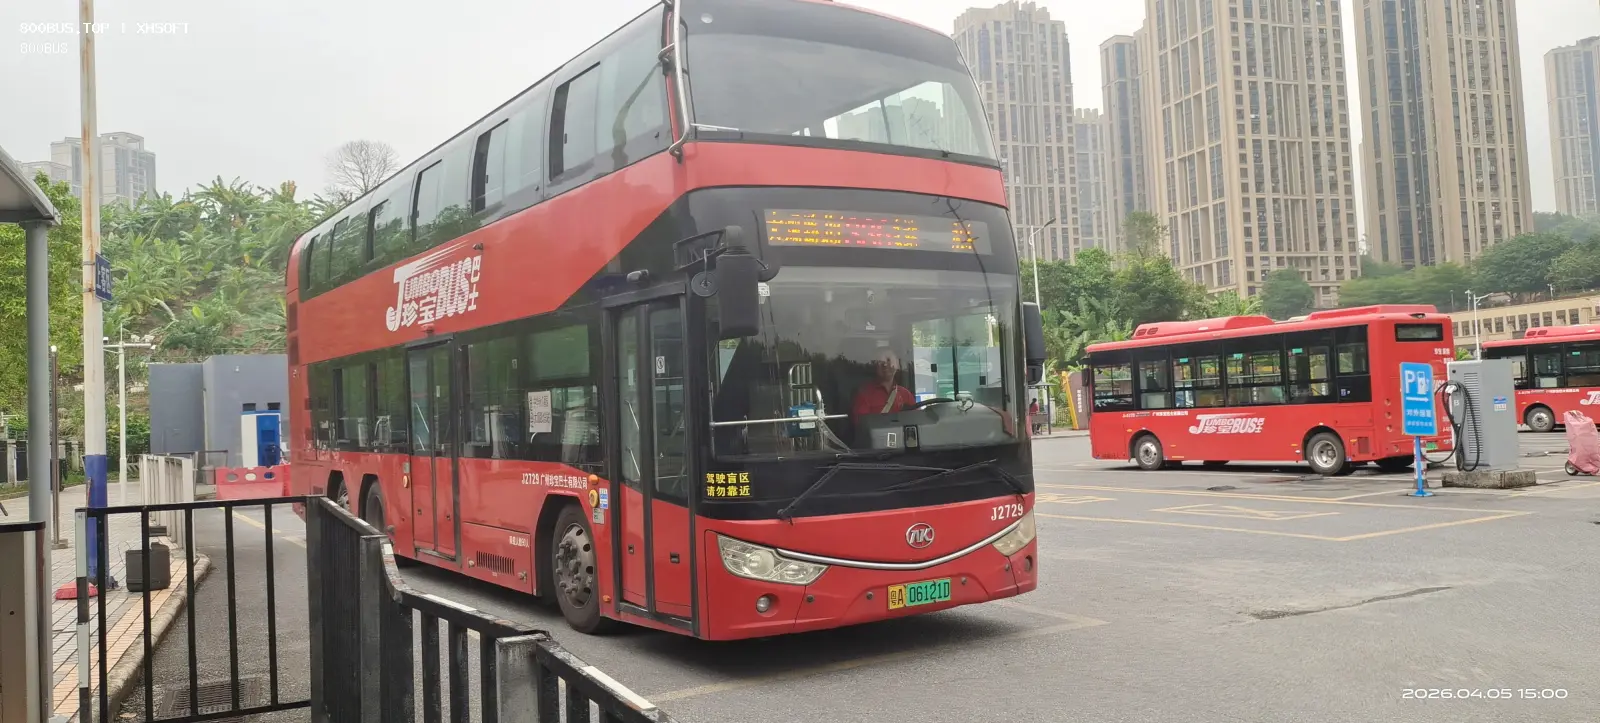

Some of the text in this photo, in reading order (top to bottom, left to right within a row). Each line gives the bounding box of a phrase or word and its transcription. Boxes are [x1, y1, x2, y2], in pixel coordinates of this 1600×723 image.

[522, 473, 588, 490] J2729 广州珍宝巴士有限公司
[706, 472, 750, 484] 驾驶盲区
[706, 485, 750, 497] 请勿靠近
[991, 503, 1024, 521] J2729
[909, 581, 950, 603] 06121D
